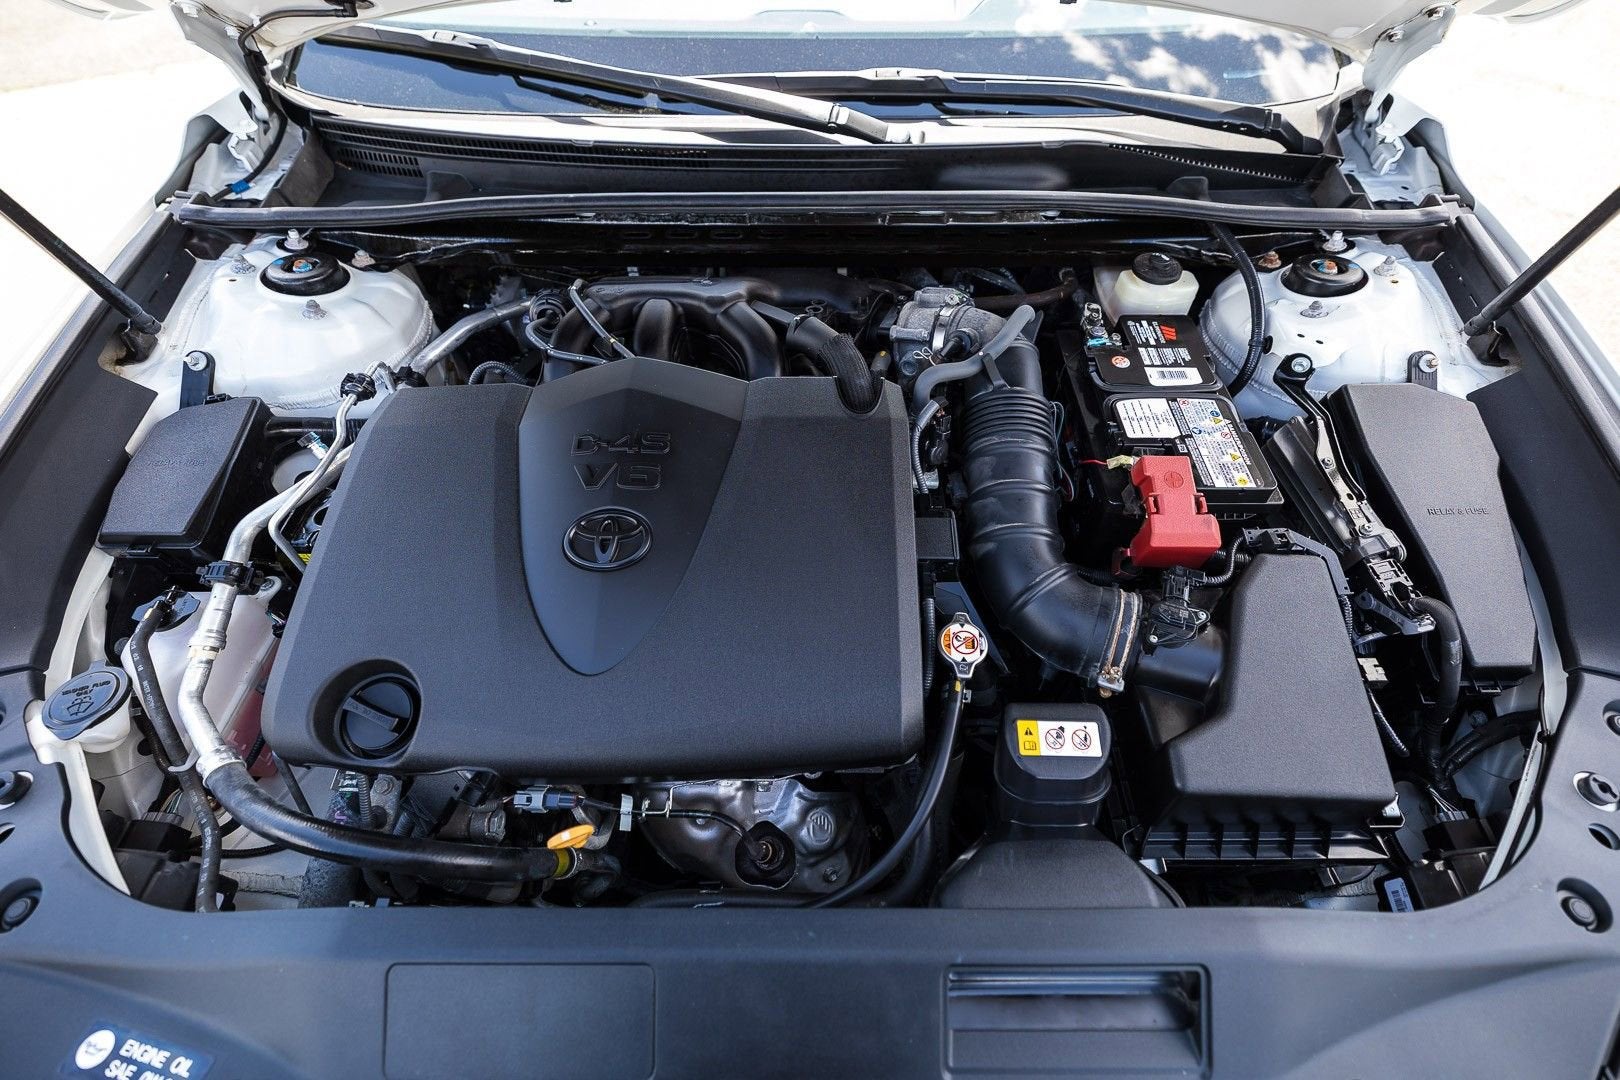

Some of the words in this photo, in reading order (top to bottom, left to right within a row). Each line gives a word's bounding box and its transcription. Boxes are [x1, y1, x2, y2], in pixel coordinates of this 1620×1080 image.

[571, 432, 672, 456] D-4S
[573, 462, 662, 490] V6
[1427, 508, 1455, 516] RELAY
[1464, 507, 1490, 515] FUSE
[104, 1059, 138, 1080] SAE
[118, 1038, 171, 1069] ENGINE
[169, 1056, 193, 1078] OIL
